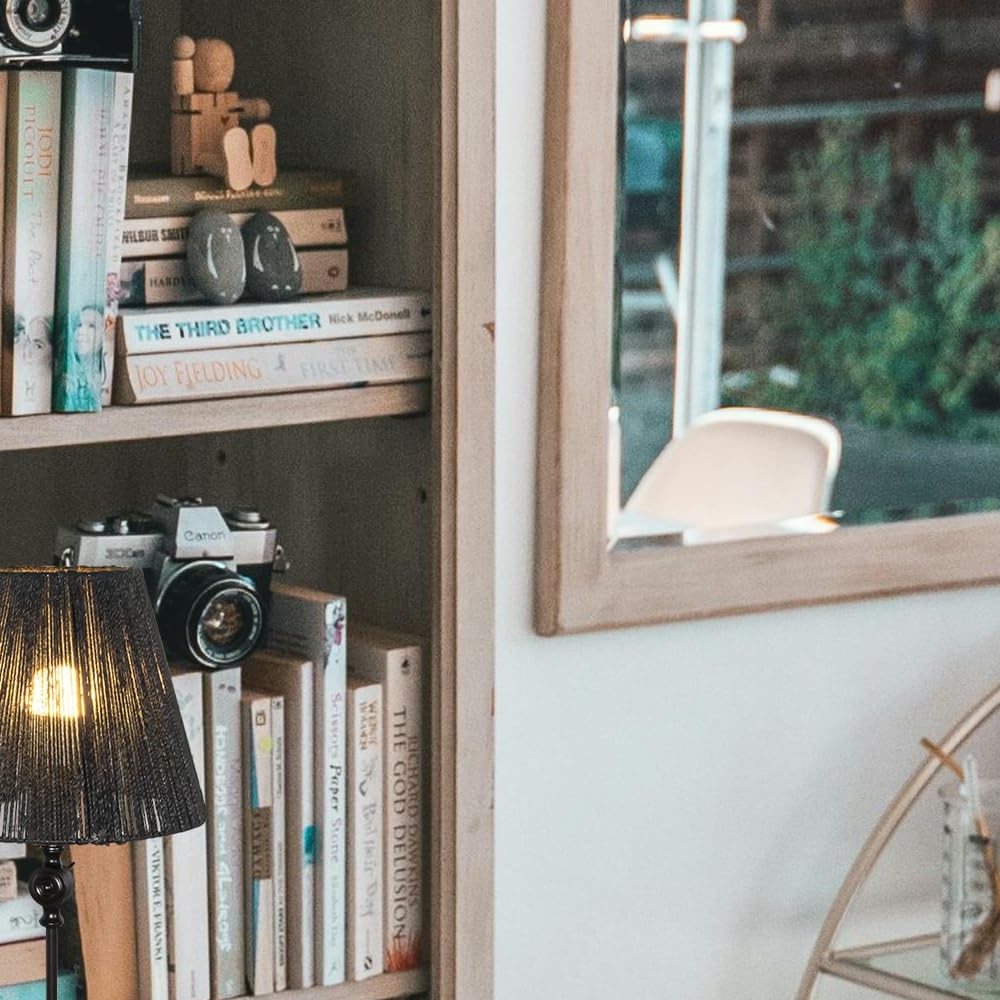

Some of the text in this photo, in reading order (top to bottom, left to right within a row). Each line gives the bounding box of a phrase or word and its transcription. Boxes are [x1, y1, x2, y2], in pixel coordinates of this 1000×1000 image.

[37, 128, 55, 177] JODI
[121, 231, 159, 244] WILBUR
[135, 313, 353, 342] THE THIRD BROTHER Nick
[133, 358, 263, 393] JOY FIELDING
[183, 530, 227, 543] Canon
[329, 765, 342, 812] Paper
[331, 817, 342, 863] Stone
[393, 706, 407, 940] THE GOD DELUSION
[151, 849, 161, 898] VIKTOR
[407, 824, 418, 907] DAWKINS
